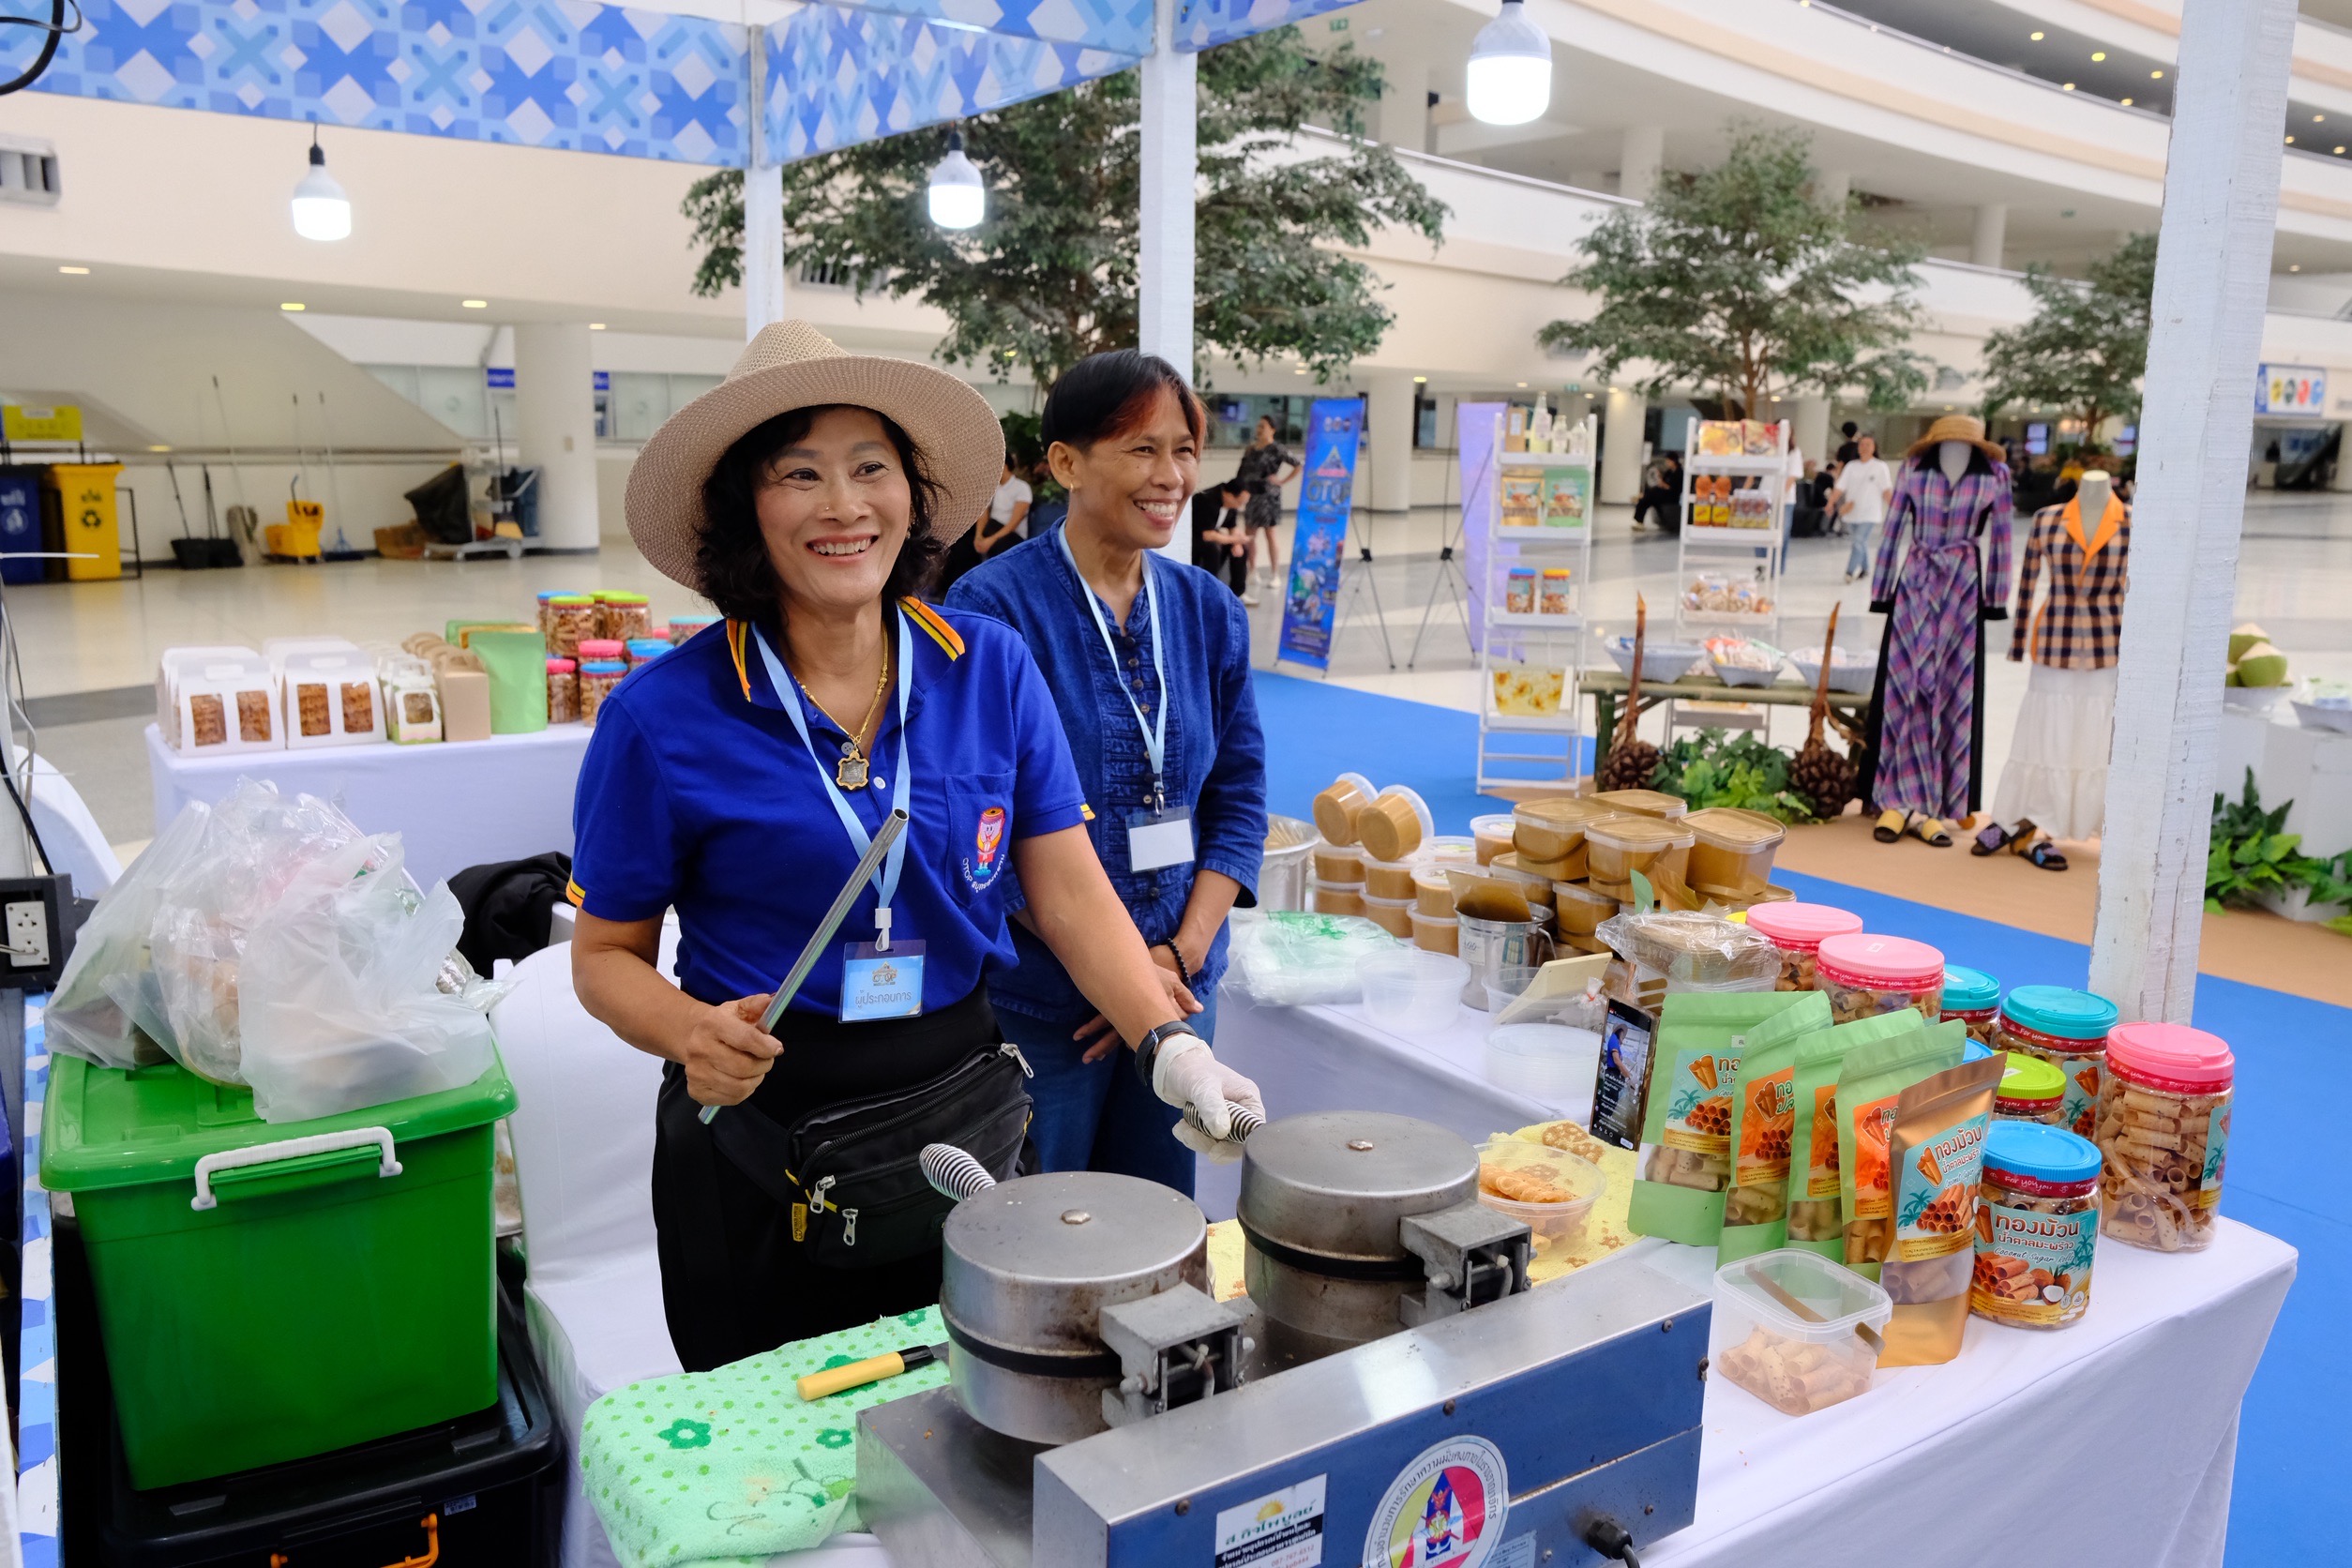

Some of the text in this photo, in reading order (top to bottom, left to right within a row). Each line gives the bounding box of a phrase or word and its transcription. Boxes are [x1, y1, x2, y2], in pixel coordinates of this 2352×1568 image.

[854, 989, 912, 1011] ผู้ประกอบการ
[1935, 1125, 1982, 1161] ทองม้วน
[1996, 1214, 2079, 1238] ทองม้วน
[1998, 1230, 2074, 1251] น้ำตาลมะพร้าว
[1994, 1247, 2027, 1259] Coconut
[2029, 1253, 2055, 1264] Sugar
